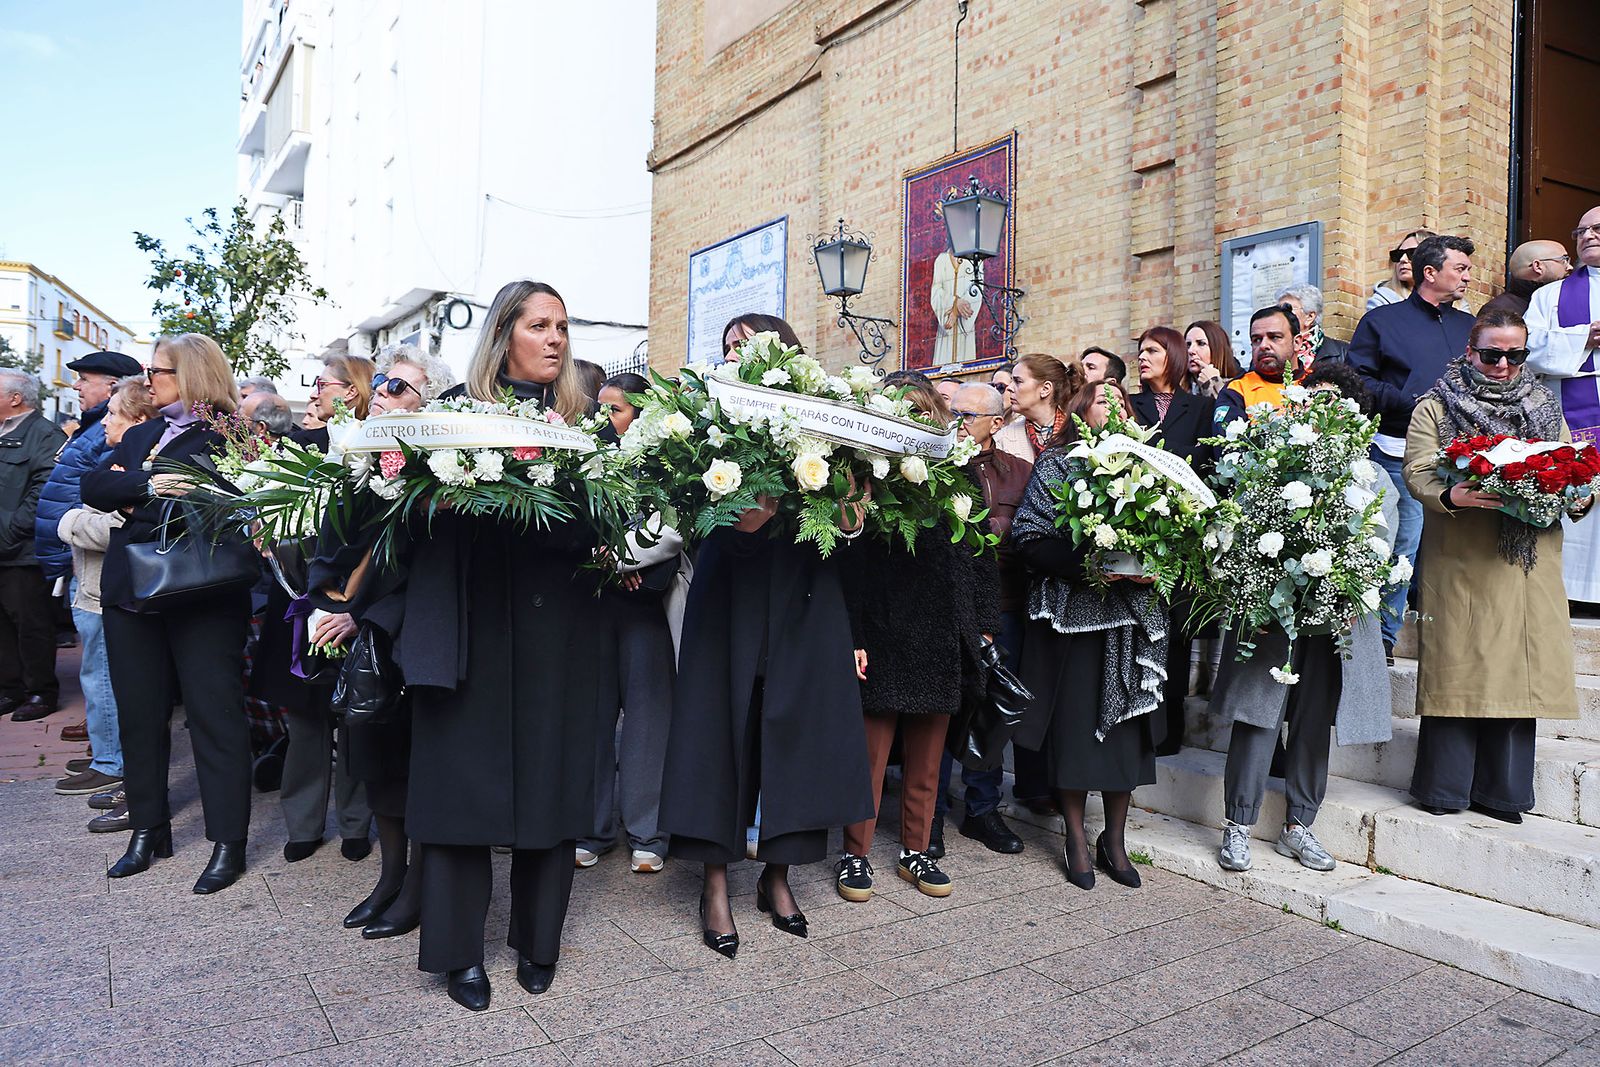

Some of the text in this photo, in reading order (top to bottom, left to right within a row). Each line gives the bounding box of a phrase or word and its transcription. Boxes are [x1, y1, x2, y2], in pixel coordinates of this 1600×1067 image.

[365, 425, 416, 438] CENTRO
[729, 395, 777, 412] SIEMPRE
[782, 404, 829, 422] STARAS
[831, 415, 854, 429] CON
[856, 421, 869, 433] TU
[871, 426, 904, 443] GRUPO
[904, 436, 917, 447] DE
